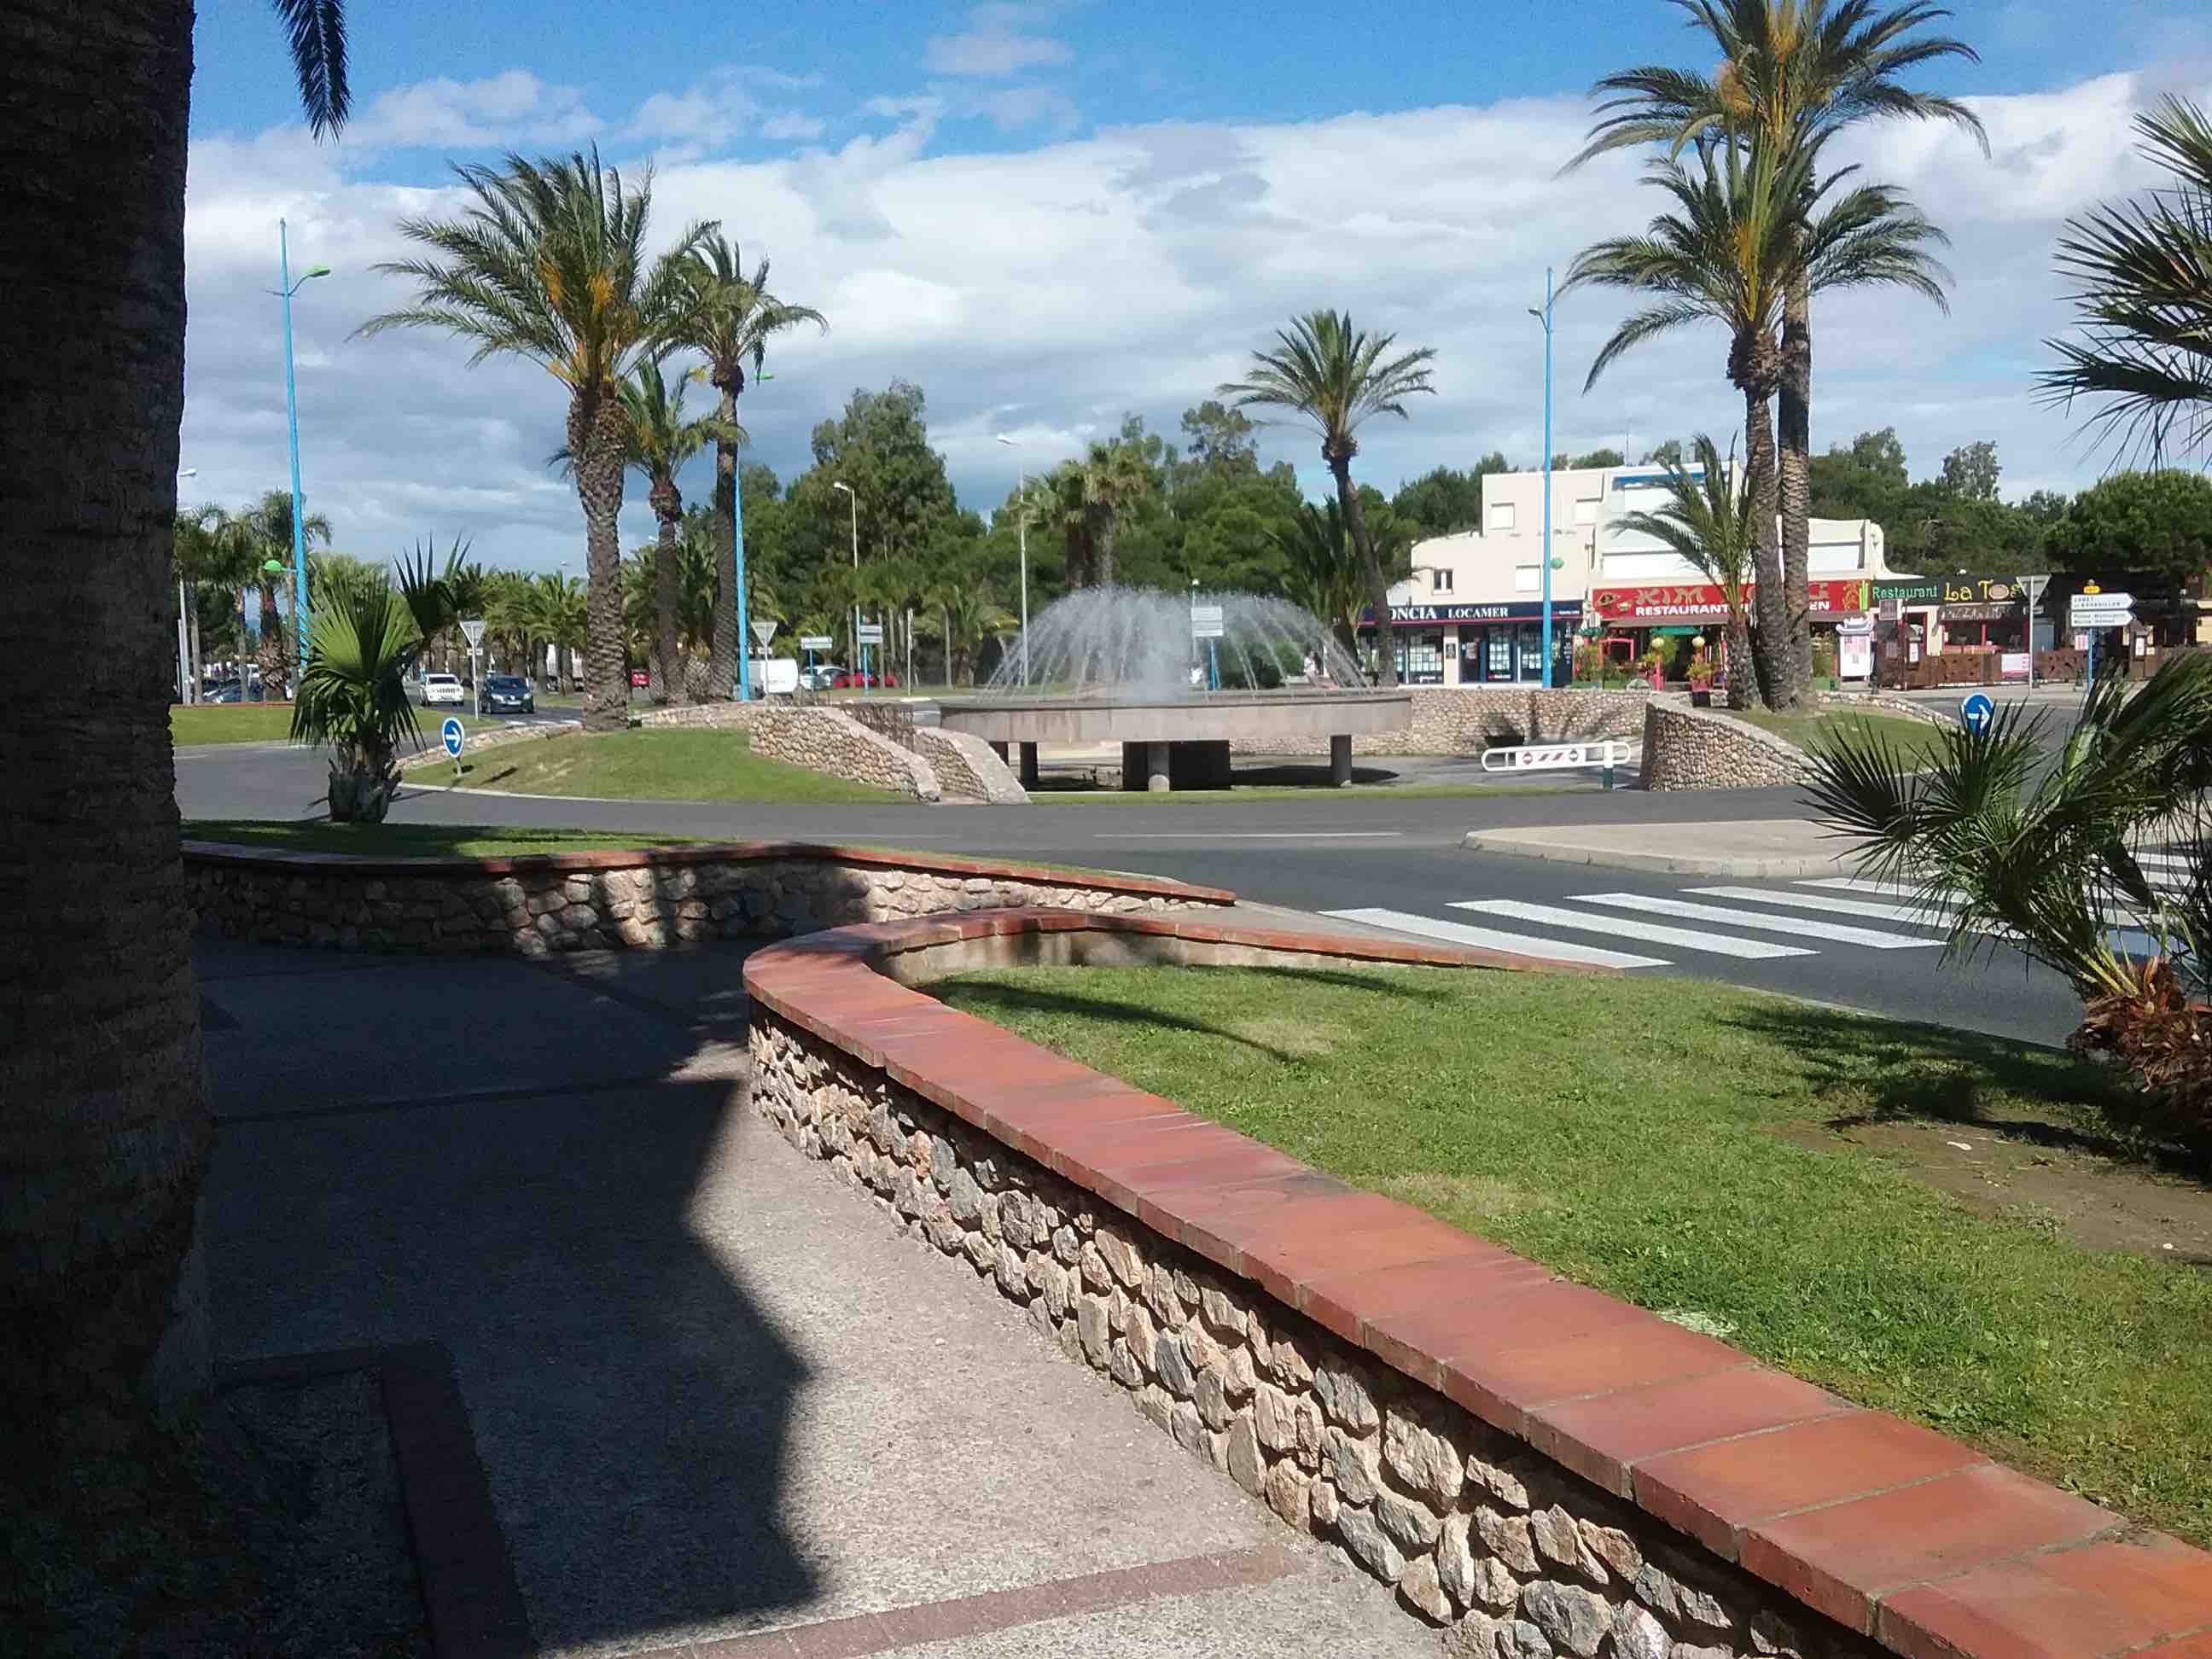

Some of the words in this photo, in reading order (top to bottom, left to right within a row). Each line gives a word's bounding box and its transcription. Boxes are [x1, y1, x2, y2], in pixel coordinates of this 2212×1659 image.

[1637, 586, 1705, 605] KIM
[1872, 585, 1938, 600] Restaurant
[1944, 581, 1973, 602] La
[1447, 607, 1509, 618] LOCAMER
[1636, 603, 1729, 617] RESTAURANT
